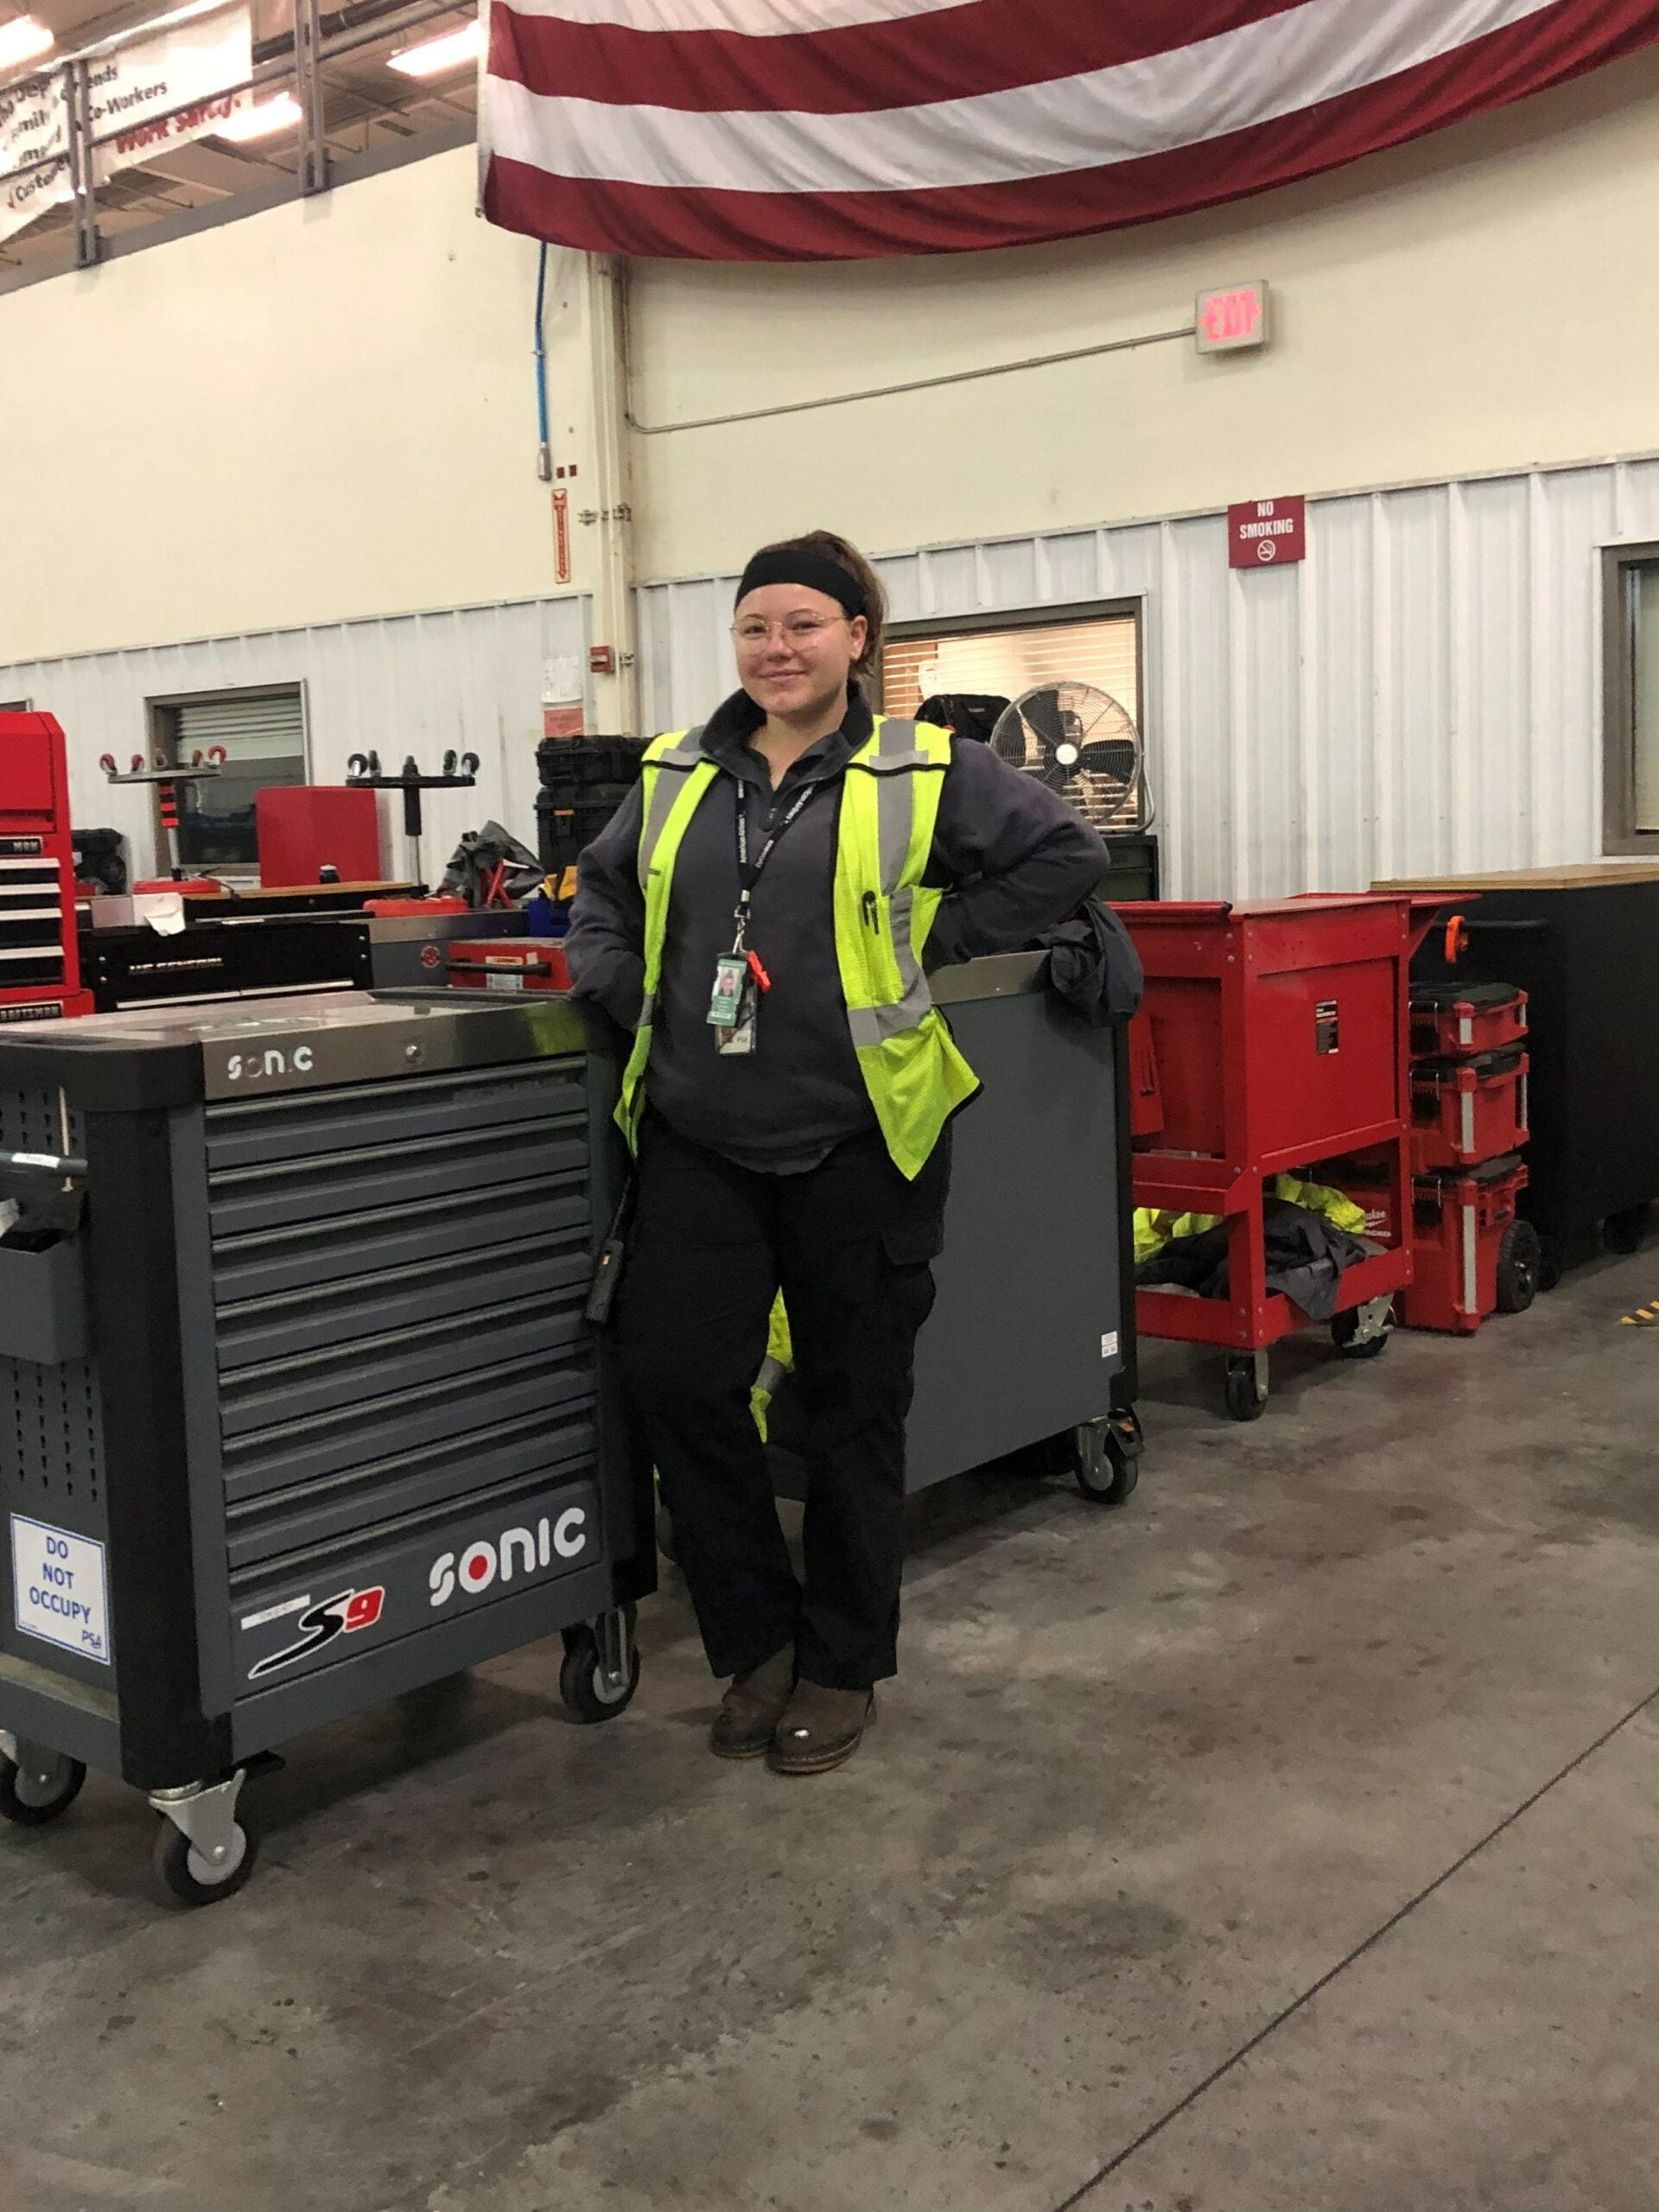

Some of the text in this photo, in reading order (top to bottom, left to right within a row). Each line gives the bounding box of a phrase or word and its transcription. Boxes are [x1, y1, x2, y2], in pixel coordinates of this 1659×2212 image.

[1206, 290, 1255, 341] EXIT
[1257, 501, 1274, 518] NO
[1239, 518, 1294, 539] SMOKING
[46, 1536, 69, 1560] DO
[429, 1507, 586, 1607] SONIC
[42, 1561, 75, 1590] NOT
[29, 1586, 92, 1624] OCCUPY
